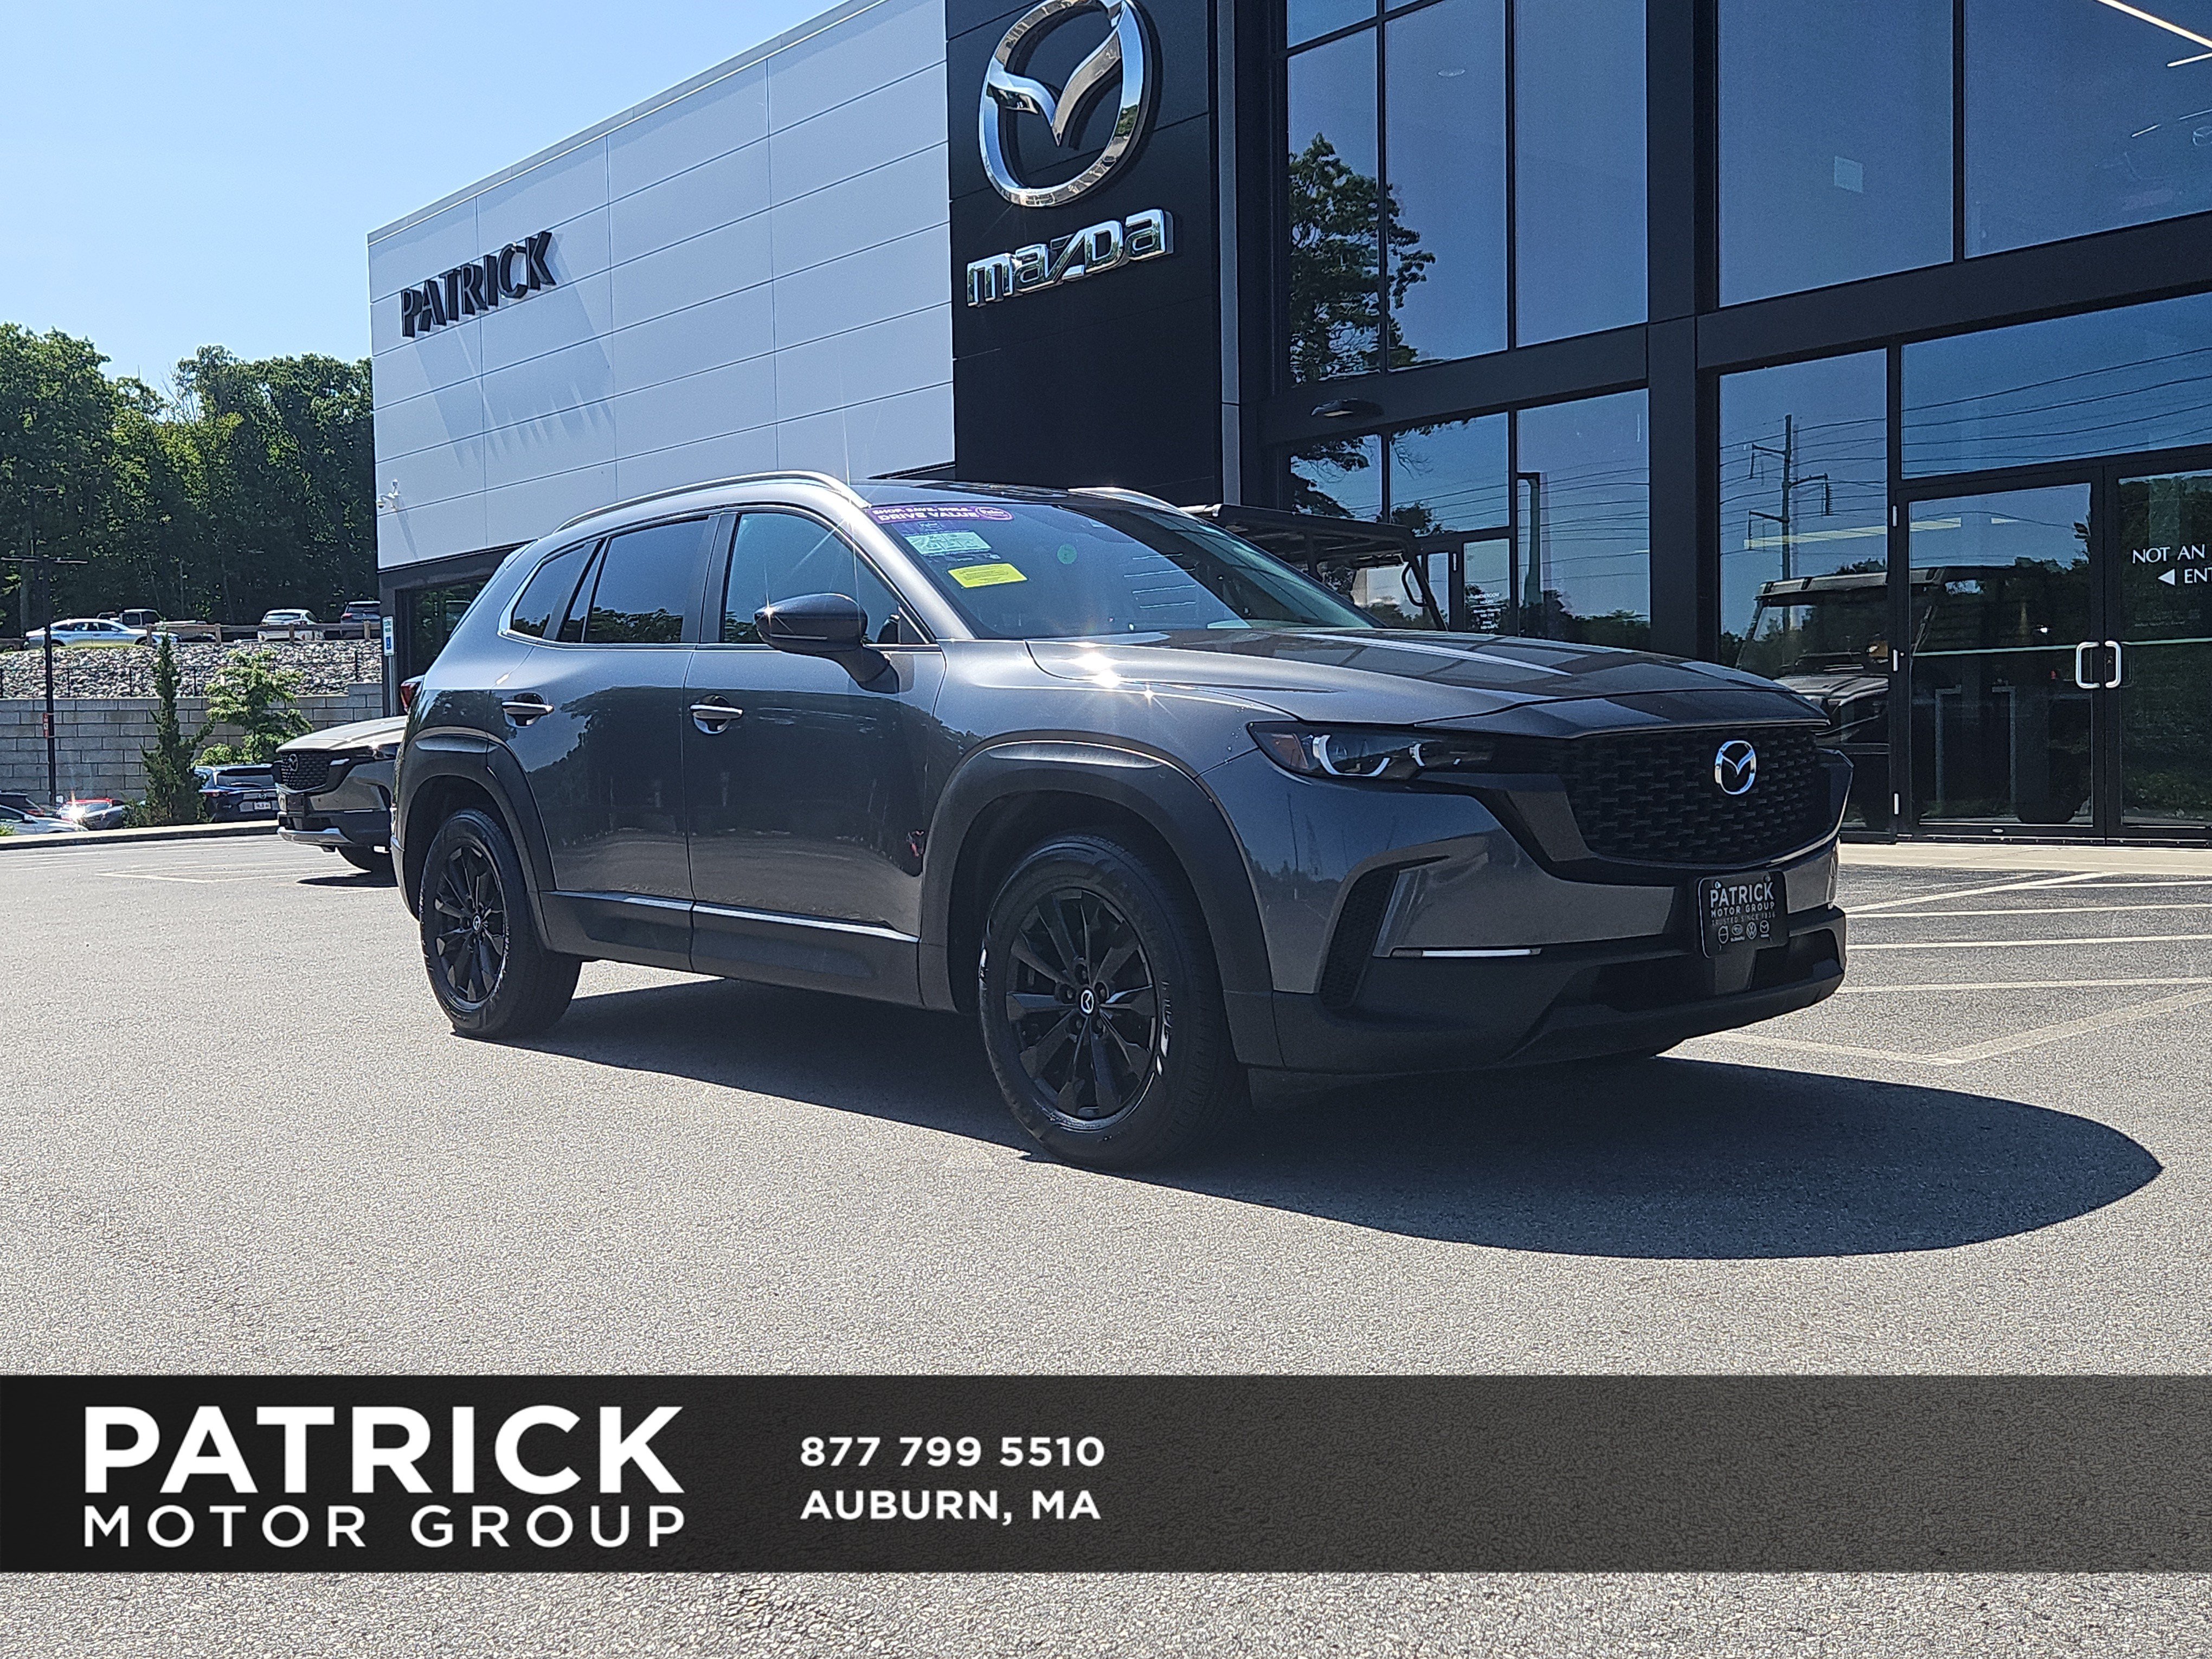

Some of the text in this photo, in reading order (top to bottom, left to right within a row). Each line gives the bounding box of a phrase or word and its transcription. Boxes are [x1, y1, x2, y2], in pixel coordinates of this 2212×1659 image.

[401, 230, 557, 338] PATRICK
[877, 512, 928, 522] DRIVE
[2132, 544, 2205, 564] NOT AN
[1710, 882, 1774, 908] PATRICK
[1711, 901, 1775, 918] MOTOR GROUP
